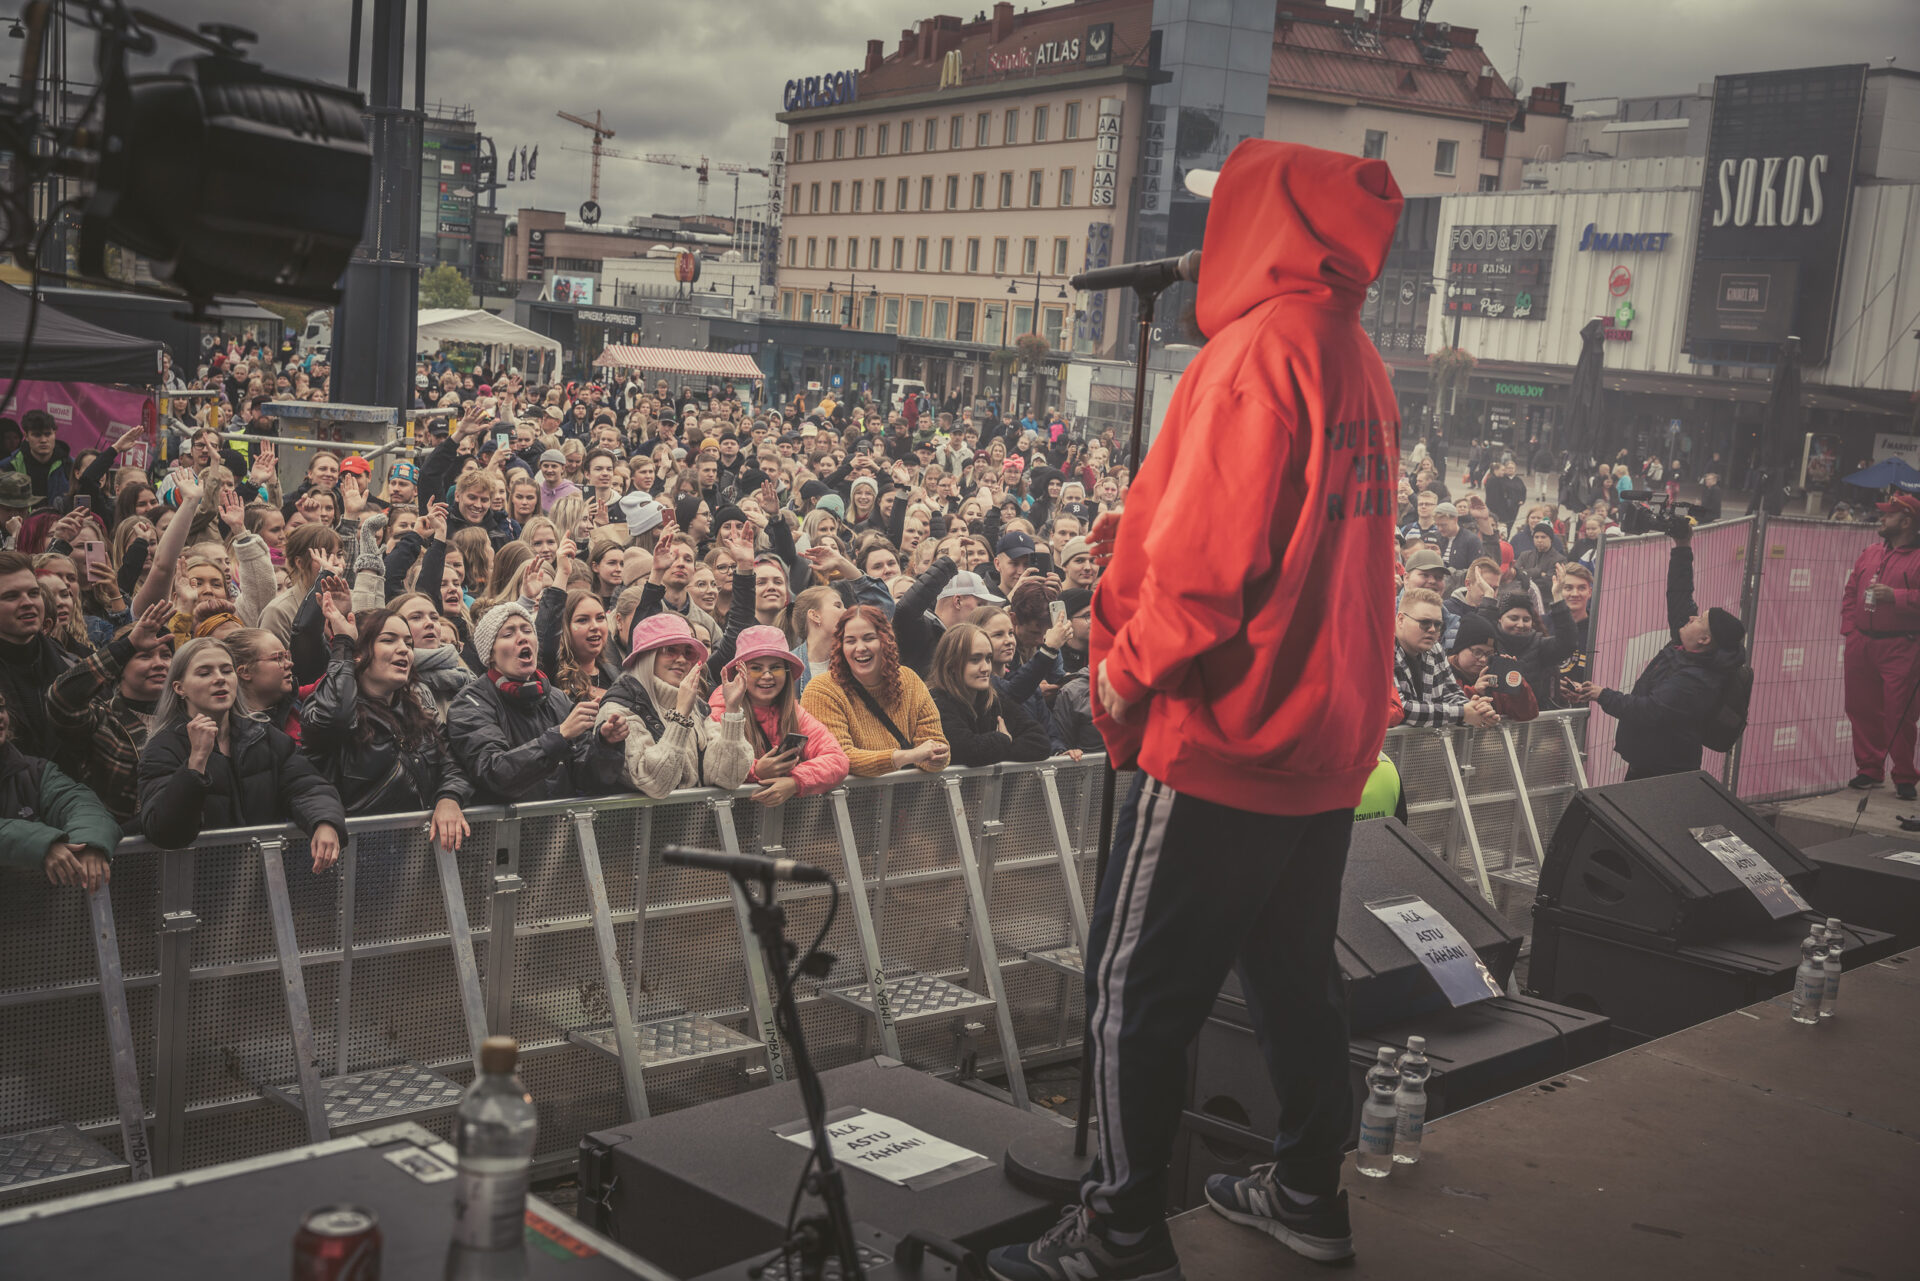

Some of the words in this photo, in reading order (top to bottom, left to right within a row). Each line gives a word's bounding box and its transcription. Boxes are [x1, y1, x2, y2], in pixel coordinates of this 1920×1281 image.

[989, 47, 1032, 72] Scandic
[1035, 38, 1081, 65] ATLAS
[784, 68, 859, 112] CARLSON
[1092, 118, 1106, 203] ATLAS
[1101, 118, 1118, 204] ATLAS
[1712, 154, 1829, 228] SOKOS
[1449, 228, 1549, 251] FOOD&JOY
[1397, 909, 1424, 924] ÄLÄ
[1415, 927, 1444, 943] ASTU
[1425, 945, 1467, 964] TÄHÄN!
[875, 968, 885, 985] OY
[877, 988, 893, 1030] TIMBA
[763, 1016, 781, 1062] TIMBA
[774, 1063, 784, 1081] OY
[826, 1122, 865, 1138] ÄLÄ
[846, 1130, 891, 1150] ASTU
[857, 1138, 926, 1162] TÄHÄN!
